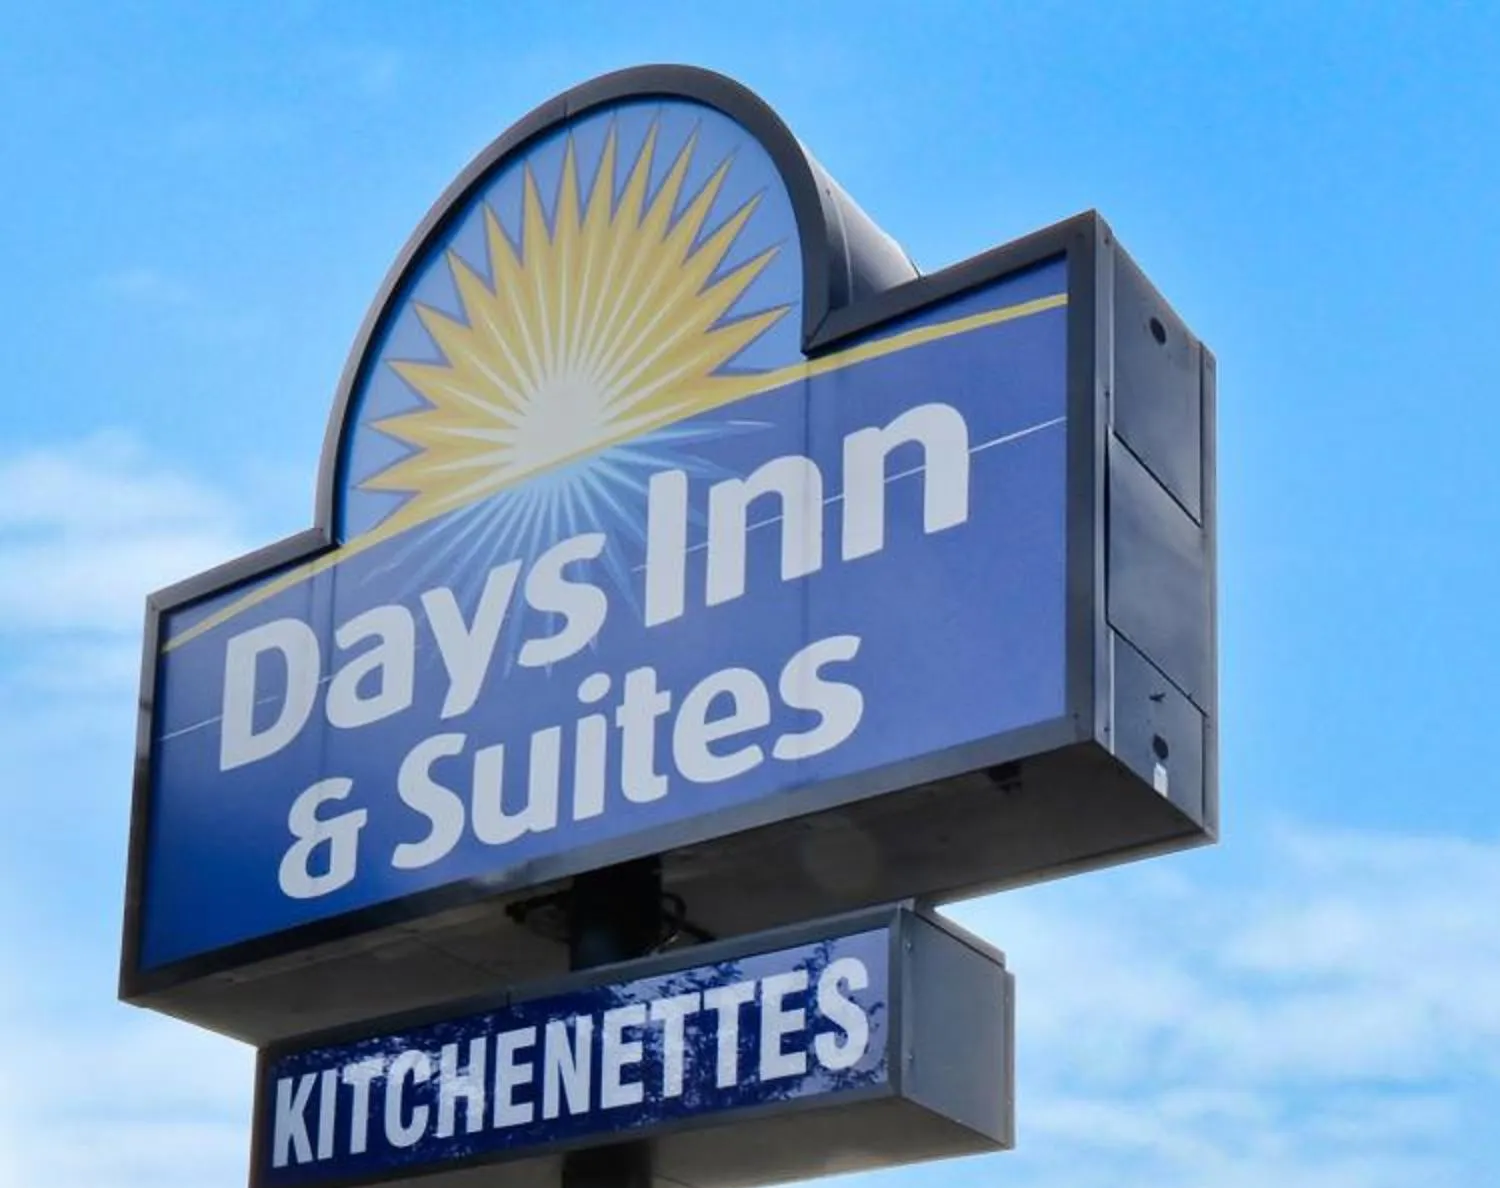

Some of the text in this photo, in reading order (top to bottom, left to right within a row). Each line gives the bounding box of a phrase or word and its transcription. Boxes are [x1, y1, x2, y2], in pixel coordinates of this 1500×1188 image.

[219, 402, 971, 769] Days Inn
[278, 635, 864, 899] & Suites
[272, 956, 871, 1167] KITCHENETTES
